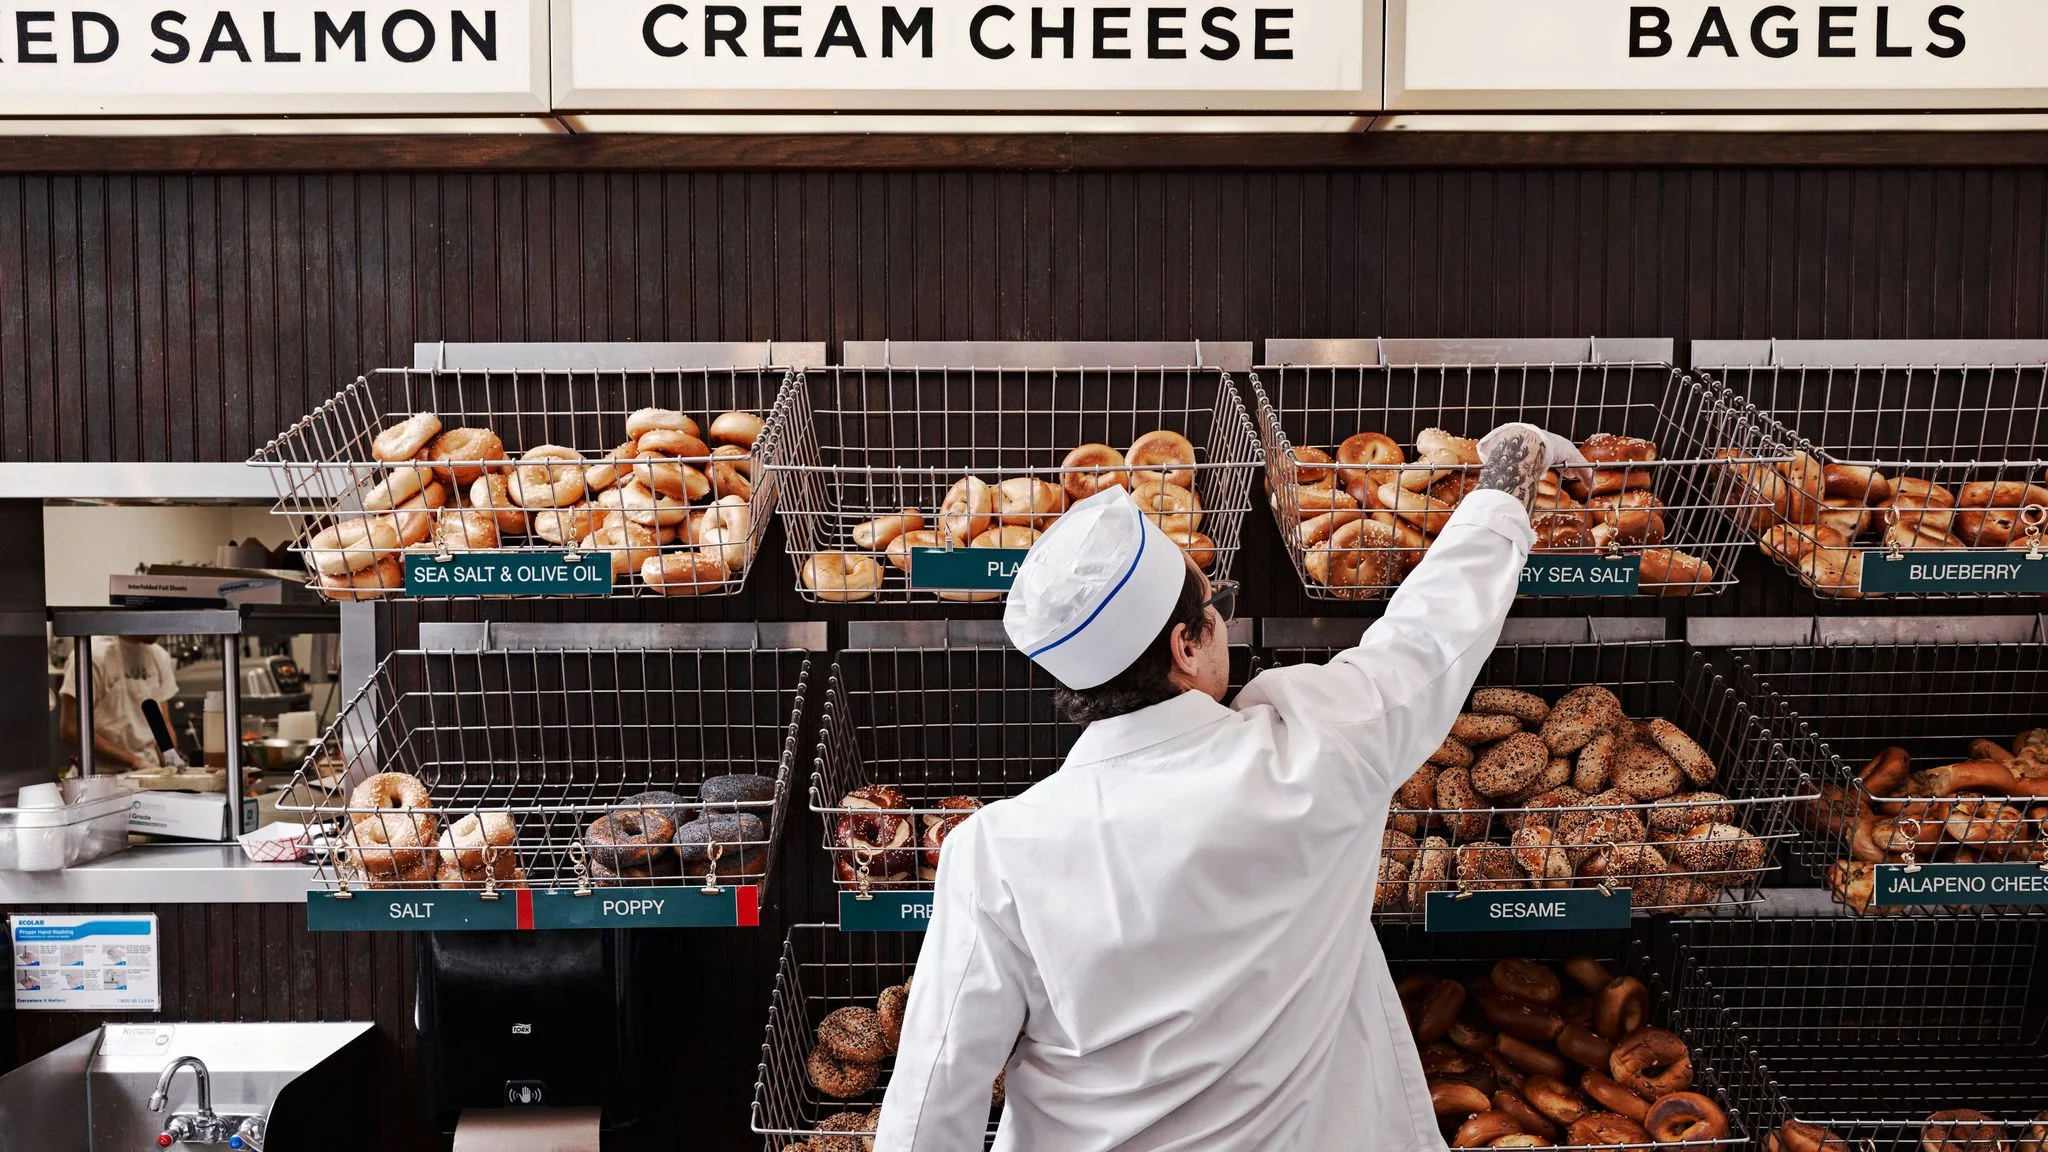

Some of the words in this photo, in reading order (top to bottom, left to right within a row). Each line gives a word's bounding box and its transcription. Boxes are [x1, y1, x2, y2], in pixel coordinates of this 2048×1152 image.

[0, 10, 120, 64] ED
[150, 8, 497, 65] SALMON
[642, 3, 934, 59] CREAM
[969, 4, 1294, 61] CHEESE
[1628, 4, 1966, 59] BAGELS
[414, 566, 450, 583] SEA
[453, 566, 496, 583] SALT
[500, 565, 513, 583] &
[517, 565, 569, 582] OLIVE
[573, 565, 603, 582] OIL
[1548, 566, 1585, 583] SEA
[1589, 567, 1634, 583] SALT
[1909, 564, 2022, 580] BLUEBERRY
[1888, 877, 1986, 893] JALAPENO
[389, 902, 435, 919] SALT
[603, 899, 665, 916] POPPY
[1489, 902, 1567, 919] SESAME
